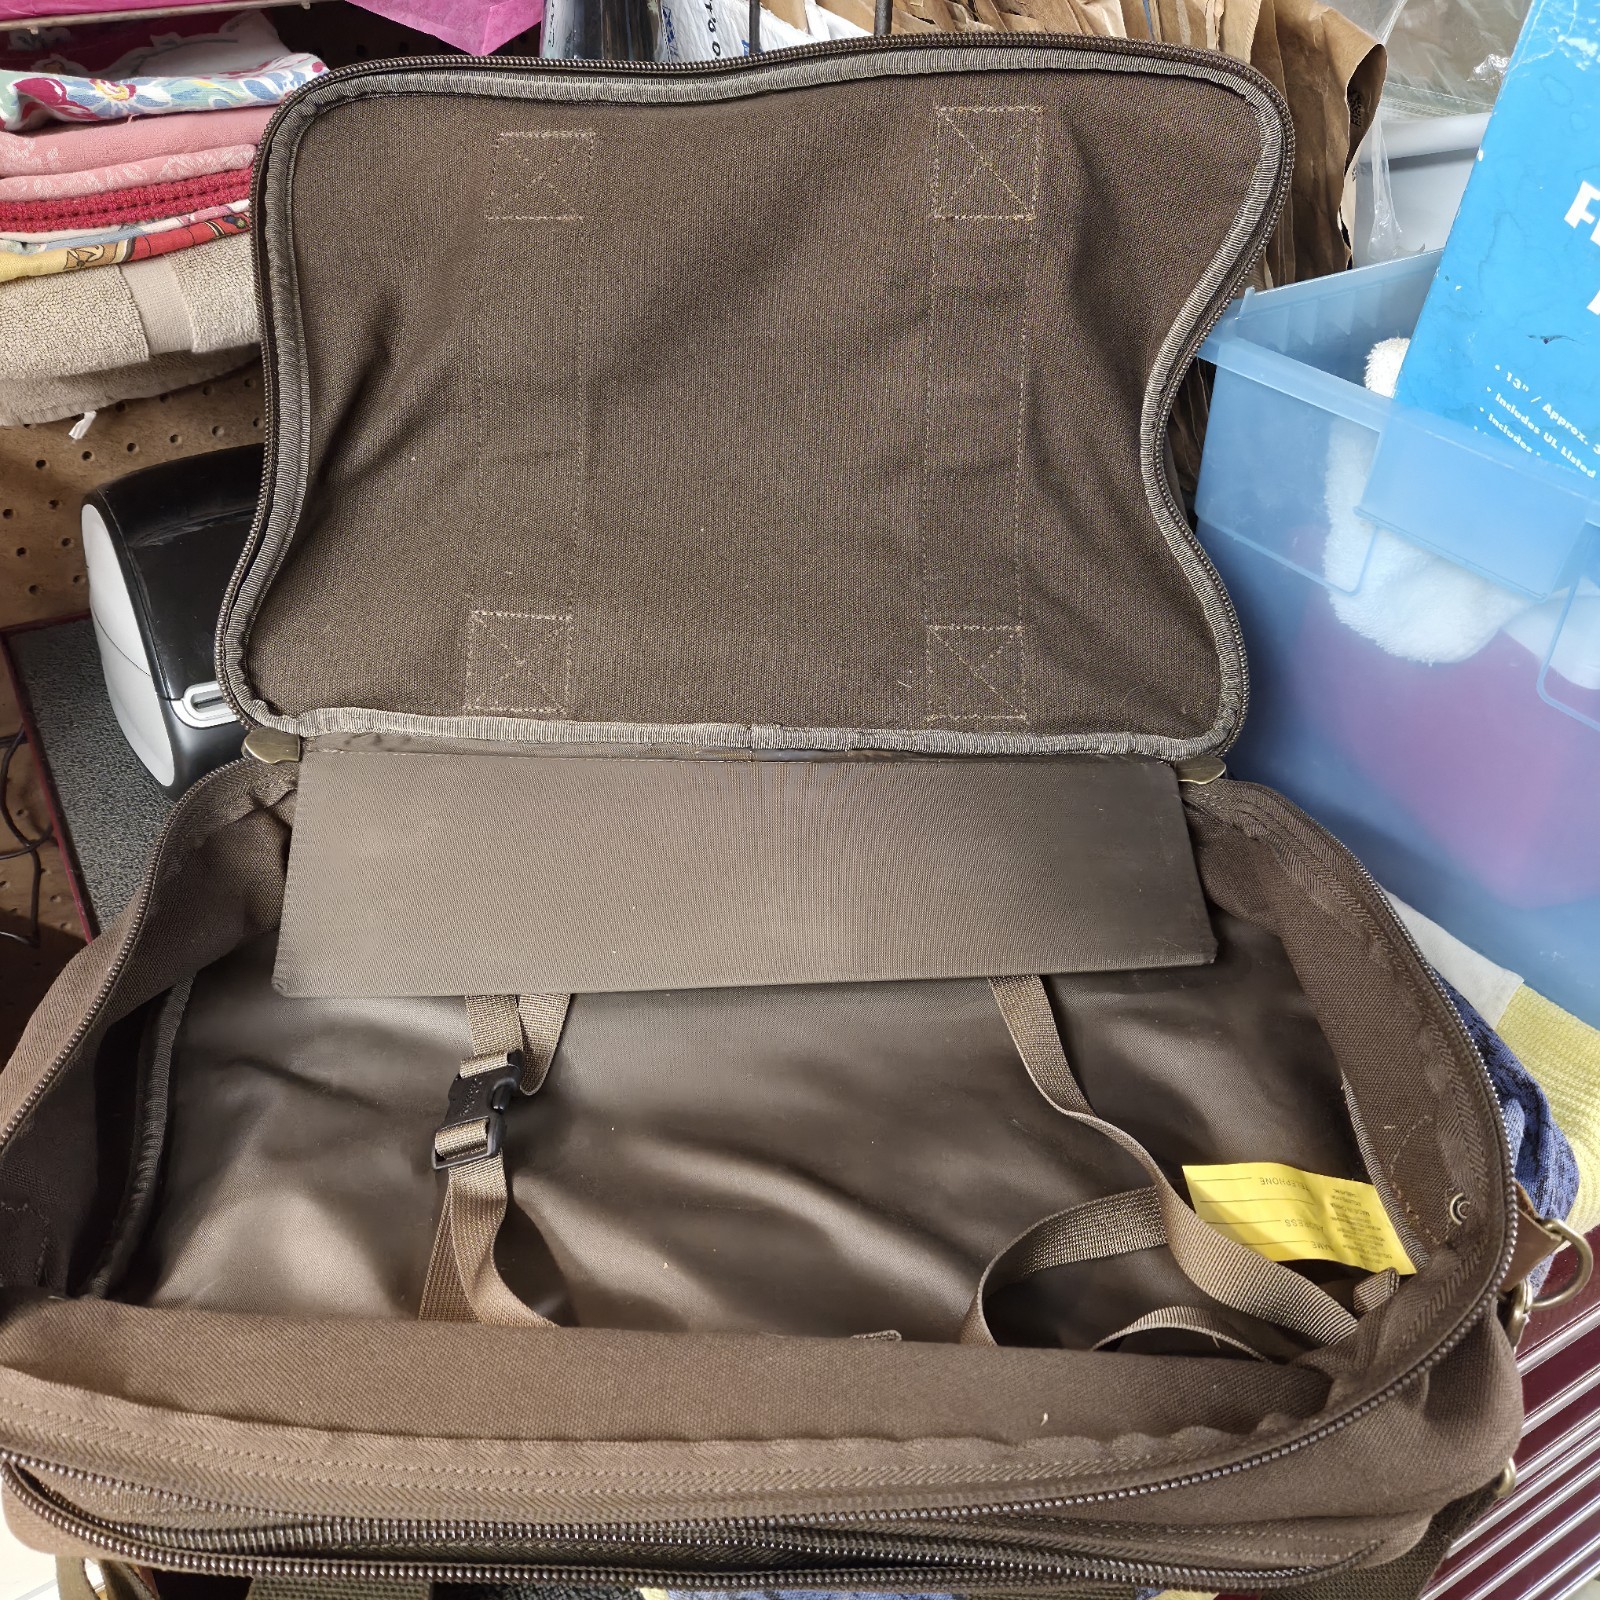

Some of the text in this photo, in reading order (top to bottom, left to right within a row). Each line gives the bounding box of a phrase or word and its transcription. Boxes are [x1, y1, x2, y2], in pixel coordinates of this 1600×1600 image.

[1563, 180, 1600, 247] F
[1488, 412, 1533, 453] Includes
[1495, 392, 1597, 478] Includes UL Listed
[1542, 403, 1588, 445] Approx.
[1260, 1176, 1311, 1192] TELEPHONE
